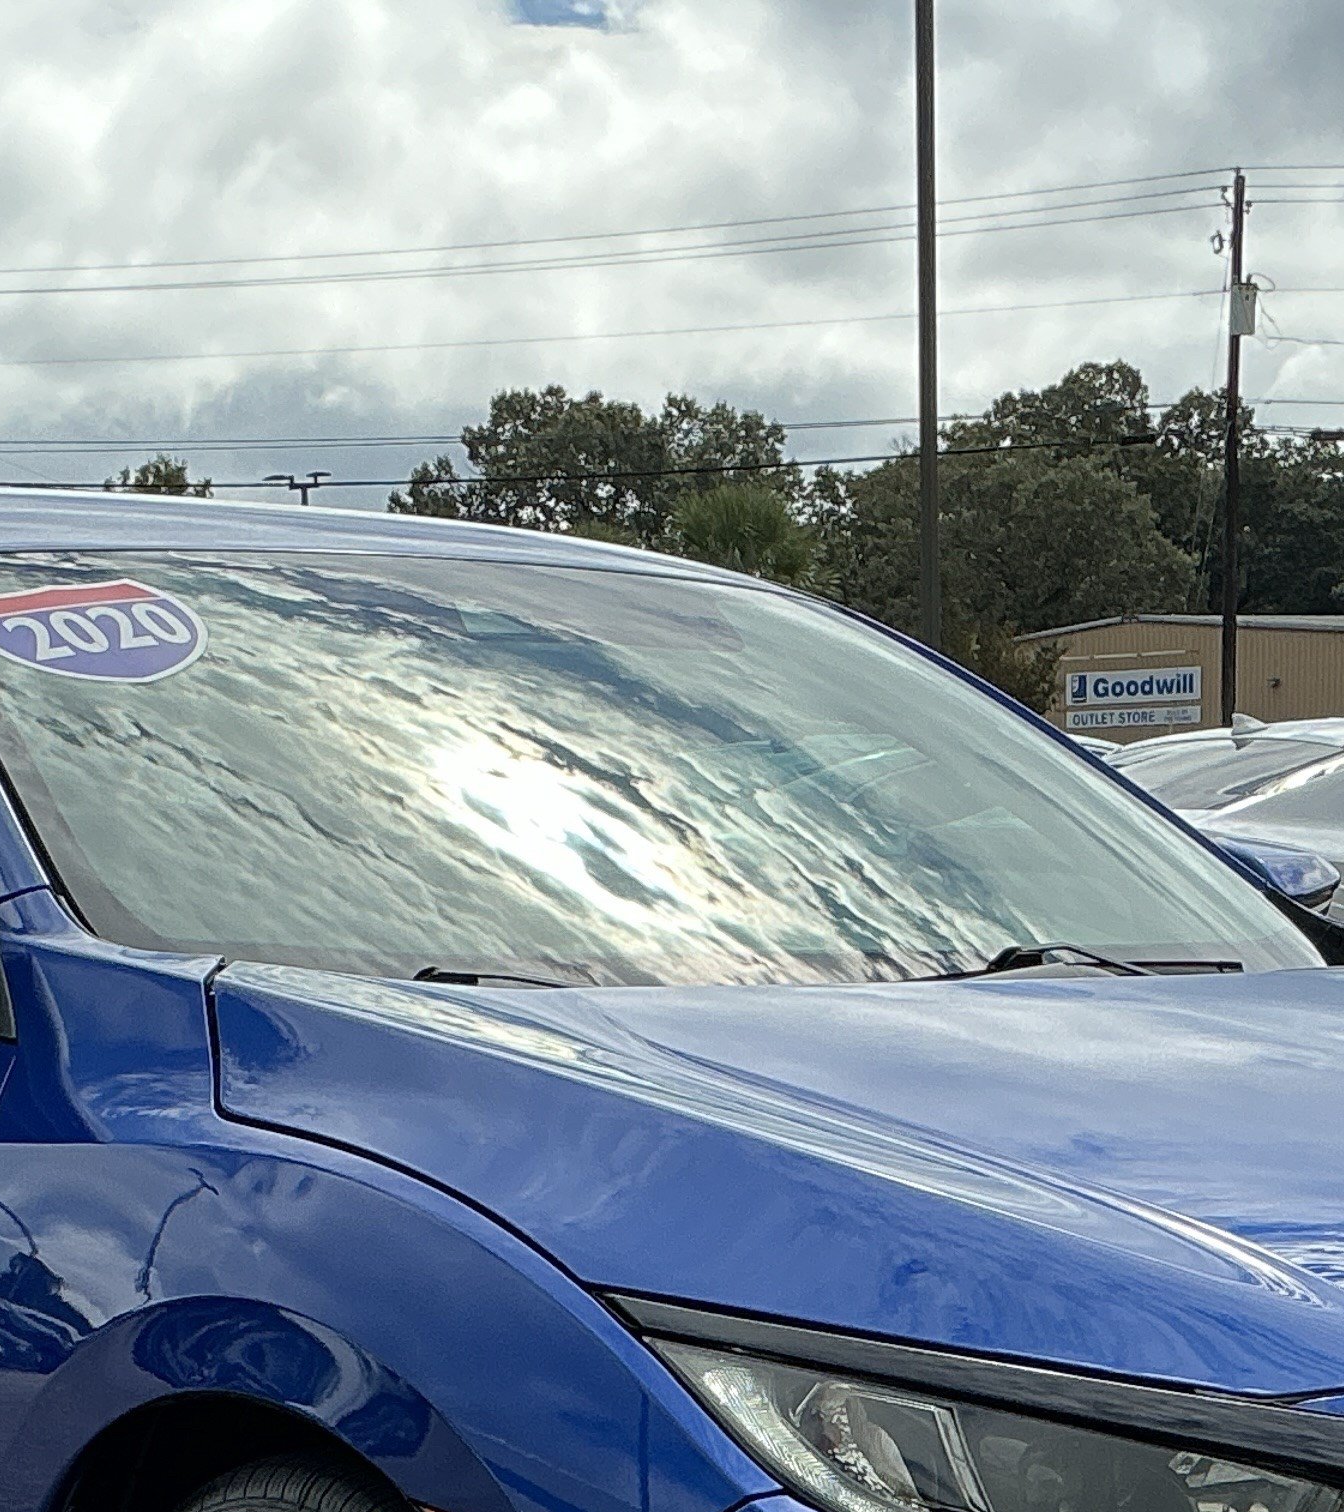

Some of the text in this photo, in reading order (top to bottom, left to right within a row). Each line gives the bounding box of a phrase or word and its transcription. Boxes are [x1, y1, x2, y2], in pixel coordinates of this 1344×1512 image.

[2, 602, 192, 661] 2020
[1093, 673, 1195, 698] Goodwill
[1072, 711, 1115, 726] OUTLET
[1118, 710, 1156, 725] STORE
